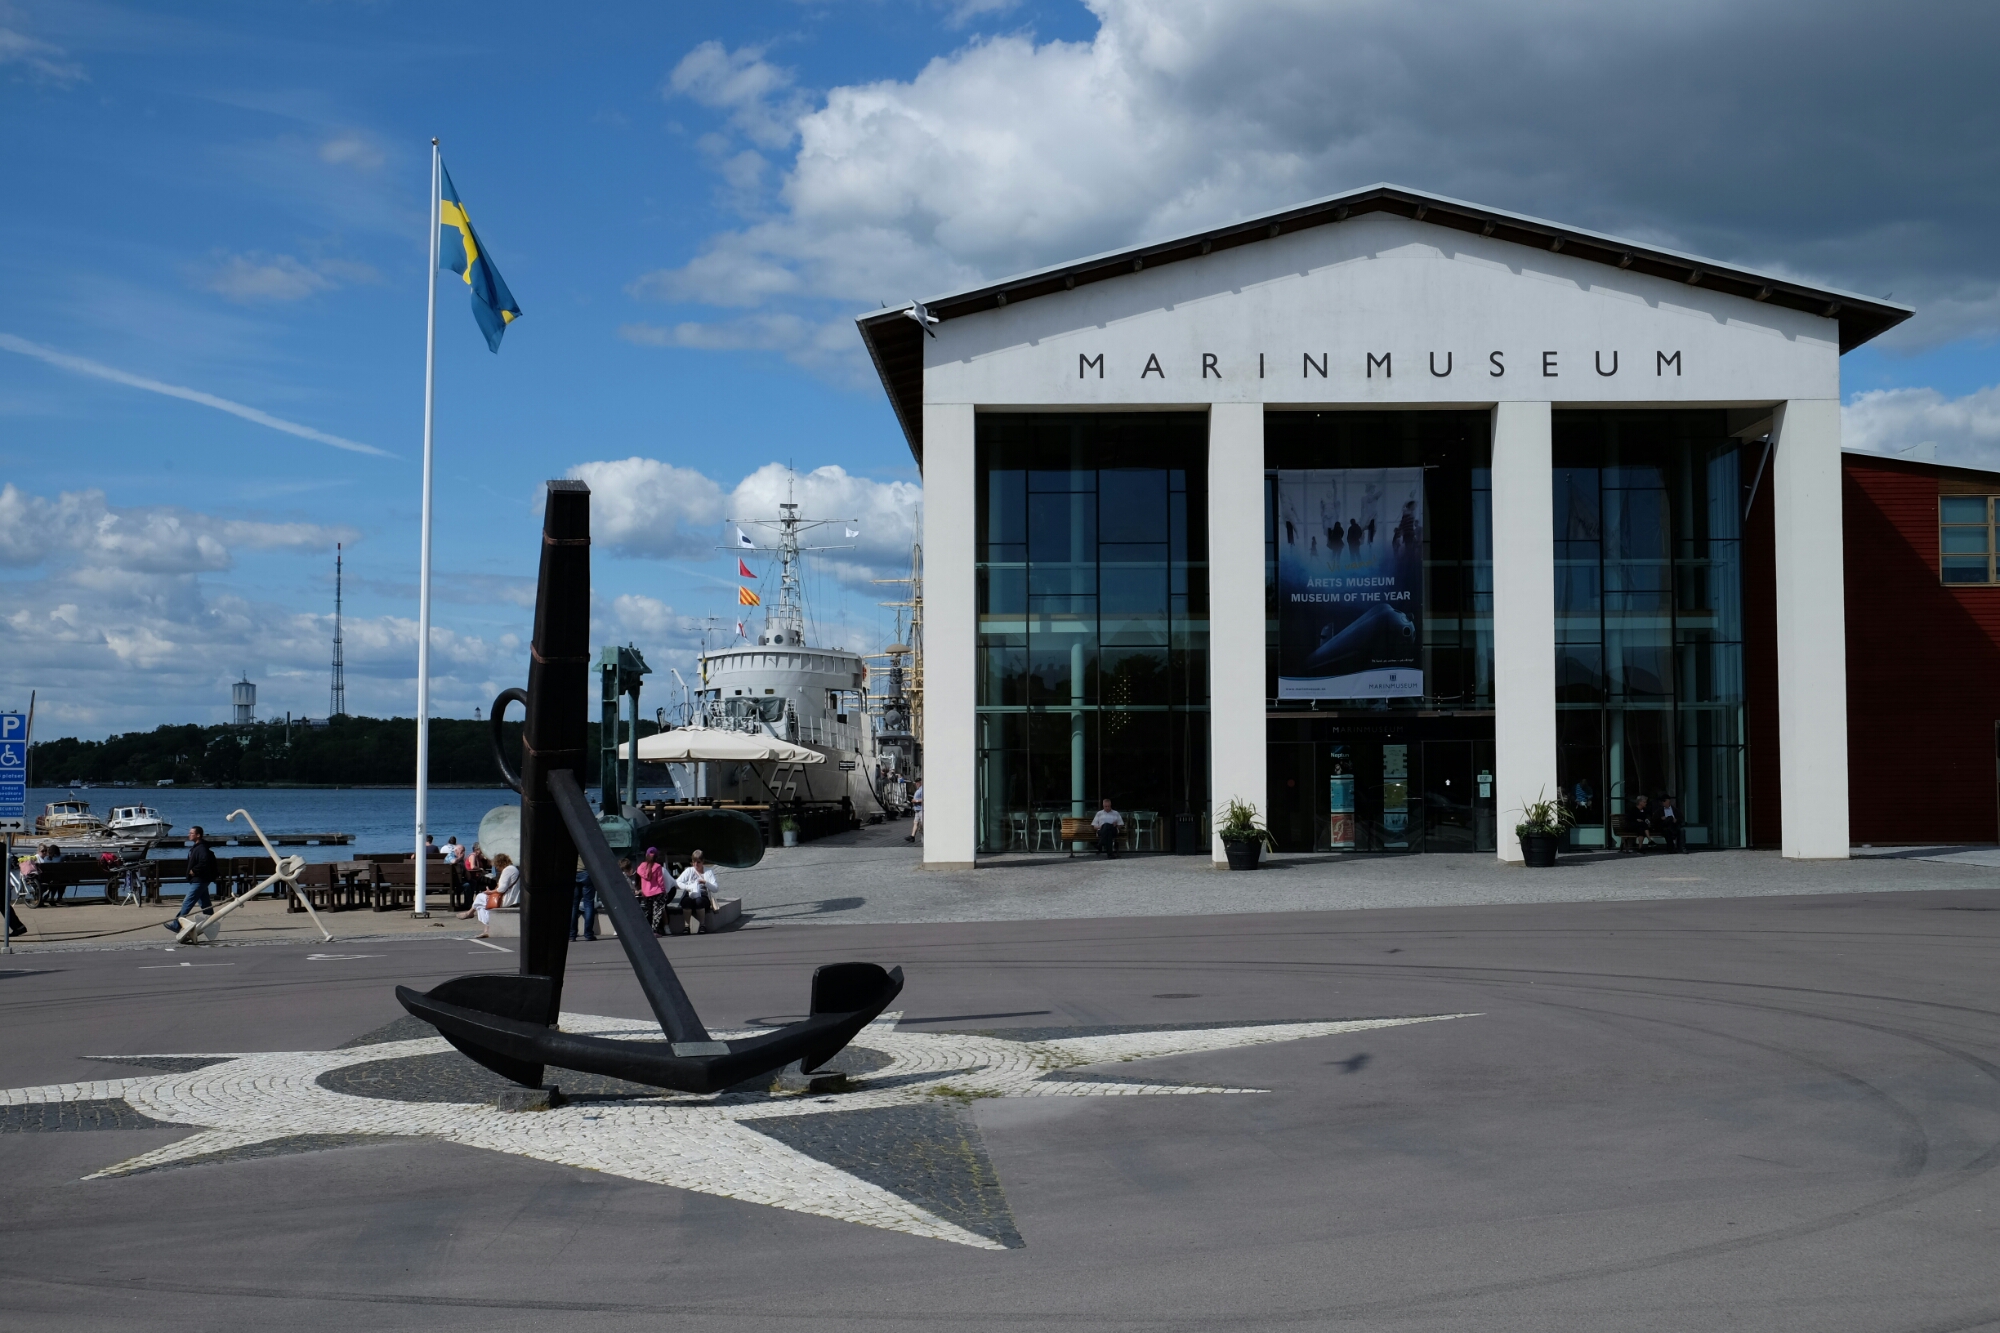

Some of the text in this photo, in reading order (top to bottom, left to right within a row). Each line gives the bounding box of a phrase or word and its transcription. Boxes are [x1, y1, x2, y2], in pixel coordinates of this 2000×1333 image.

[1078, 350, 1682, 379] MARINMUSEUM
[1307, 576, 1395, 588] ÅRETS MUSEUM
[1291, 591, 1411, 603] MUSEUM OF THE YEAR
[1368, 682, 1418, 690] MARINMUSEUM
[2, 716, 20, 738] P
